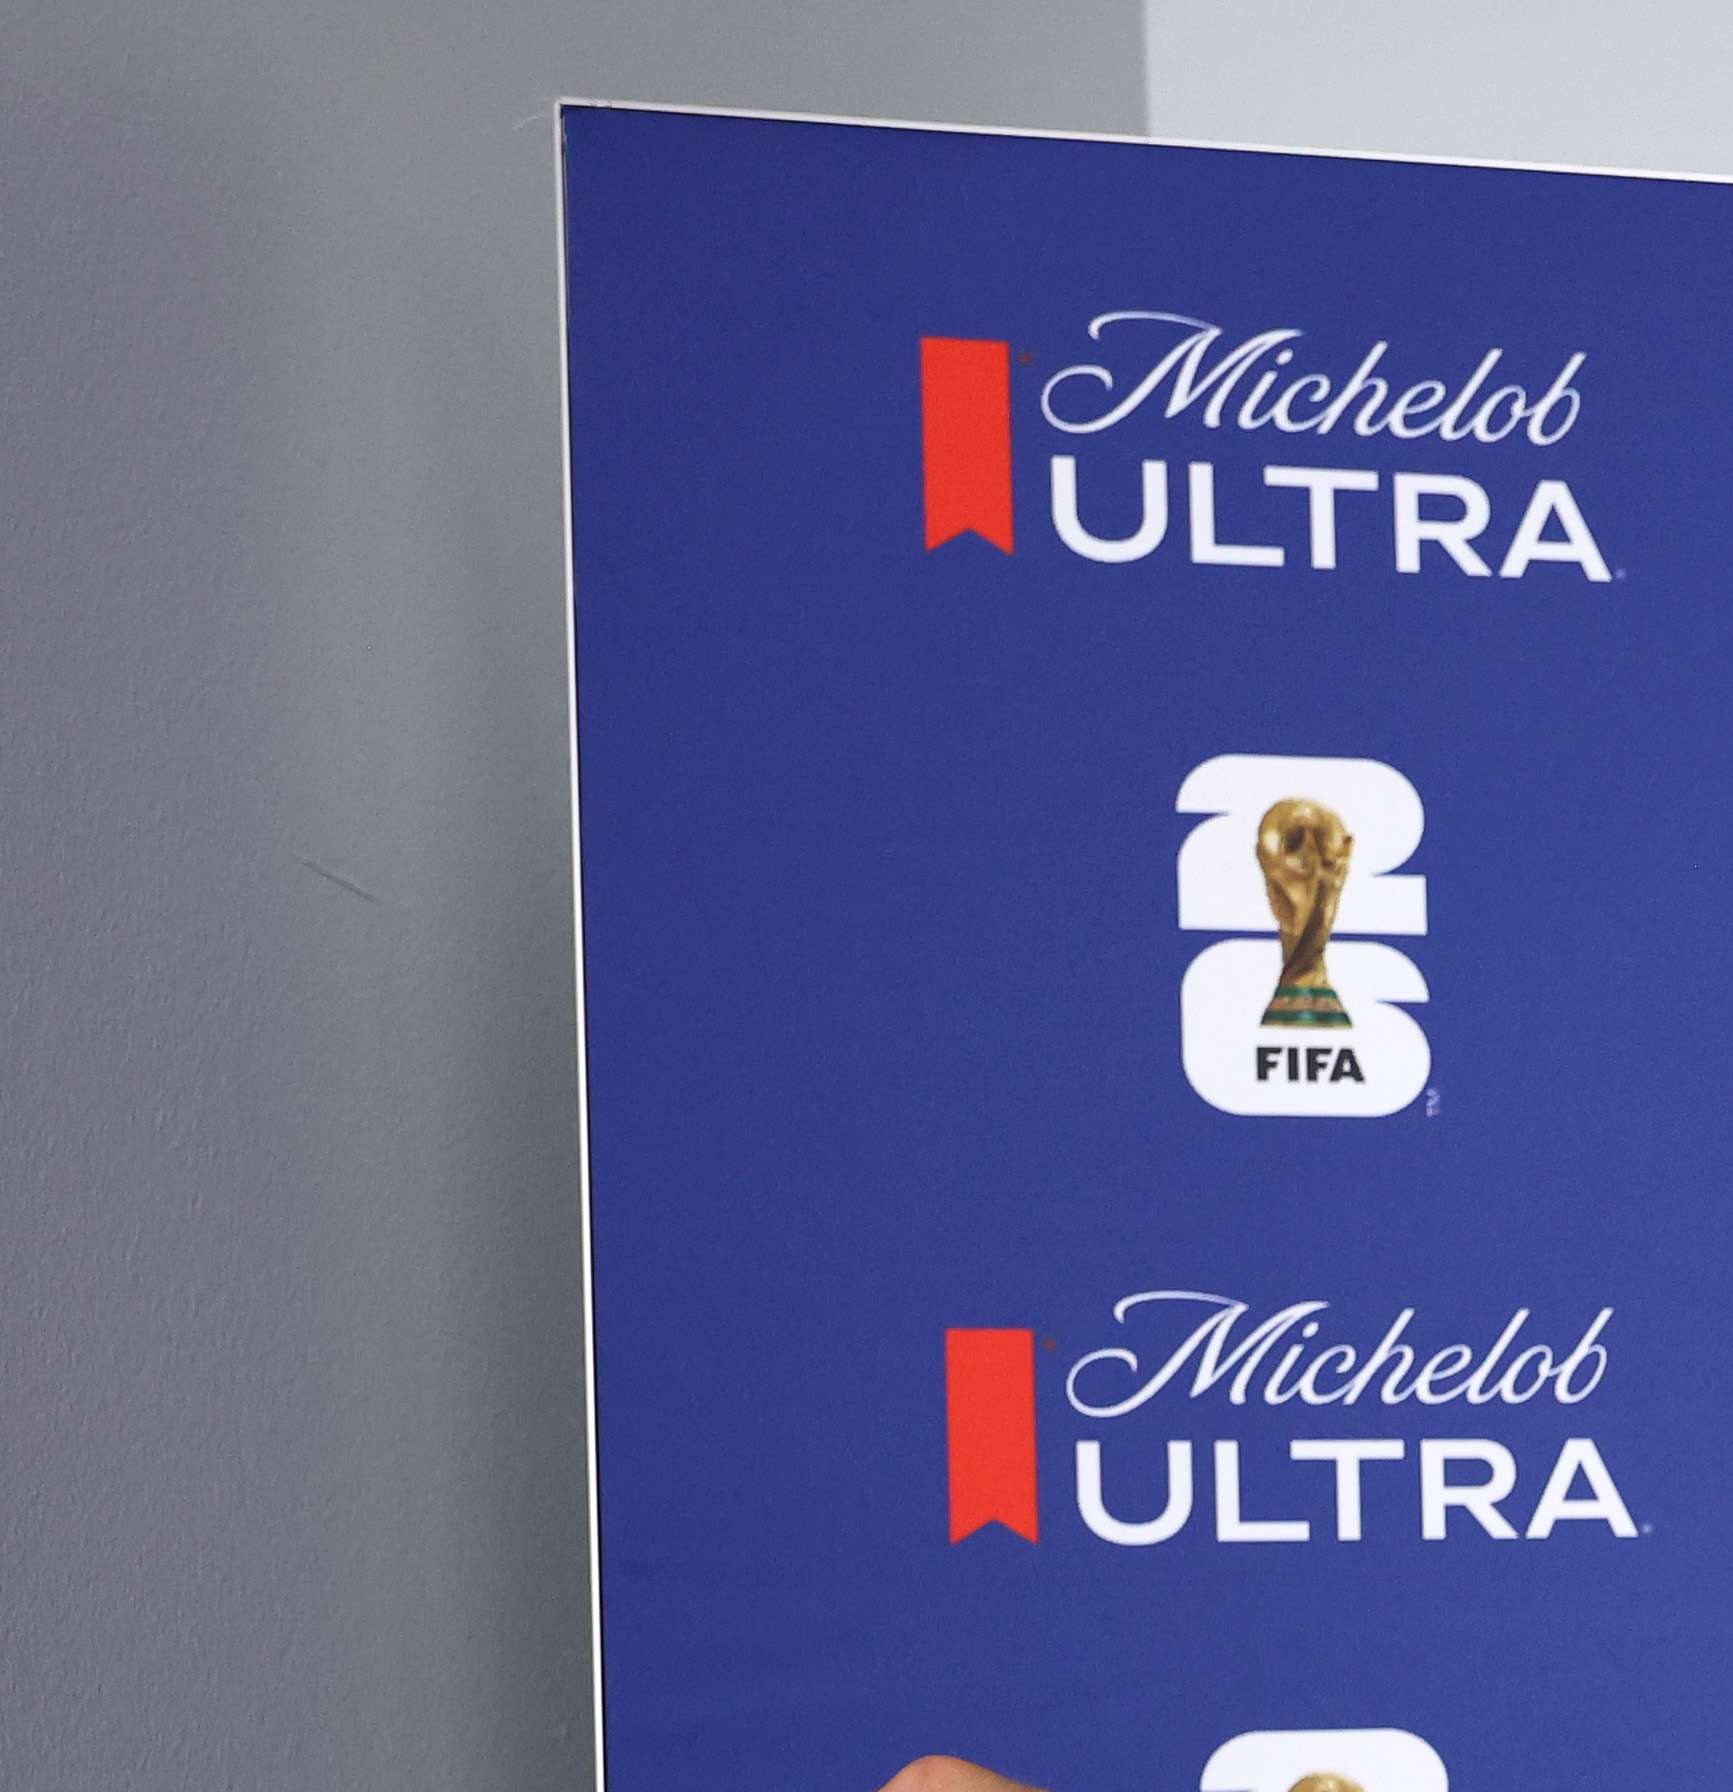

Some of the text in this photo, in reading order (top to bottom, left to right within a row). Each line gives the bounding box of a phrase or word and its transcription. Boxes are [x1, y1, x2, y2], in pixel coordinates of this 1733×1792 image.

[1042, 312, 1585, 445] Michelob
[1052, 455, 1611, 582] ULTRA
[1257, 1047, 1364, 1082] FIFA
[1067, 1291, 1612, 1417] Michelob
[1077, 1439, 1637, 1545] ULTRA
